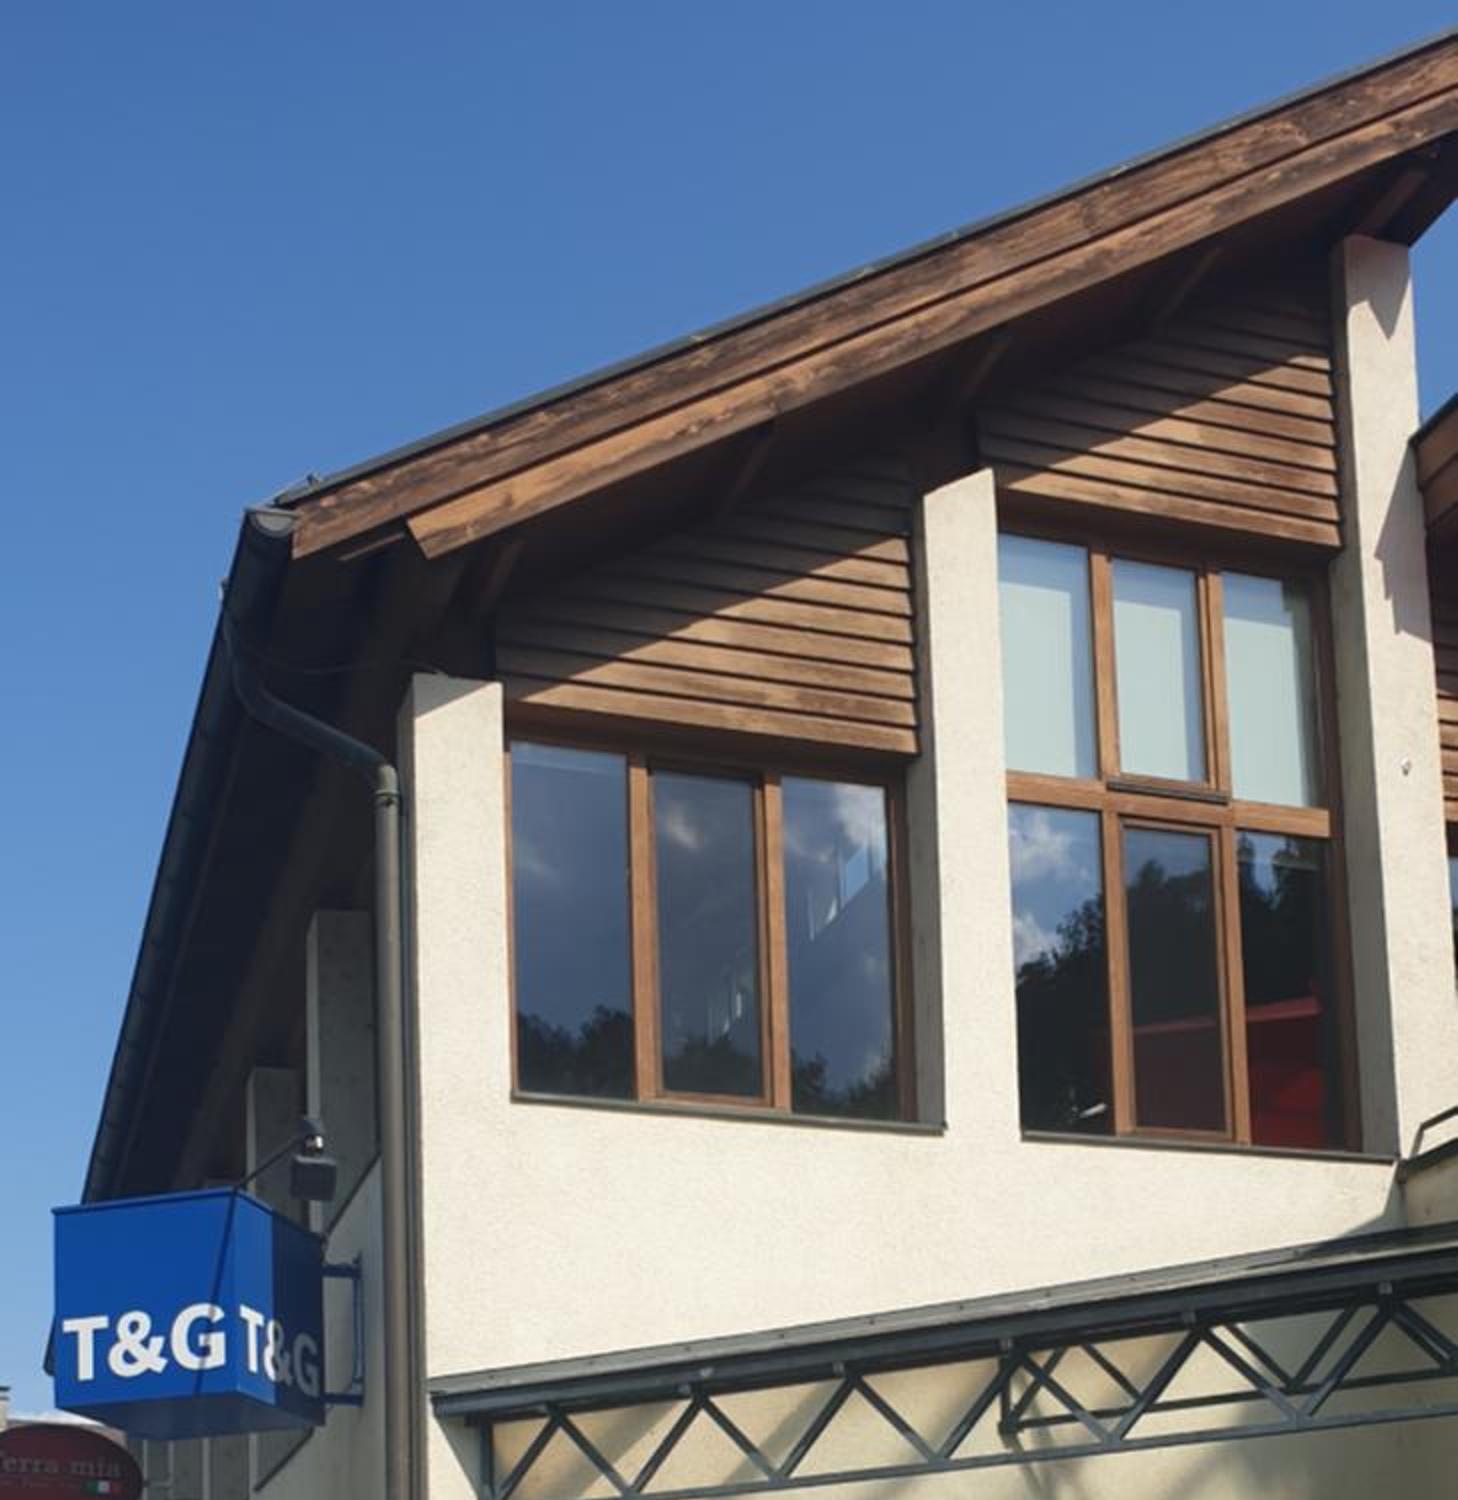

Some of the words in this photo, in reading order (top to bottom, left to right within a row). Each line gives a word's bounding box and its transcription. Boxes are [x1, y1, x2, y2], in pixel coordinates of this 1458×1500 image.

[63, 1303, 226, 1382] T&G
[240, 1304, 320, 1397] T&G
[0, 1450, 59, 1474] erra
